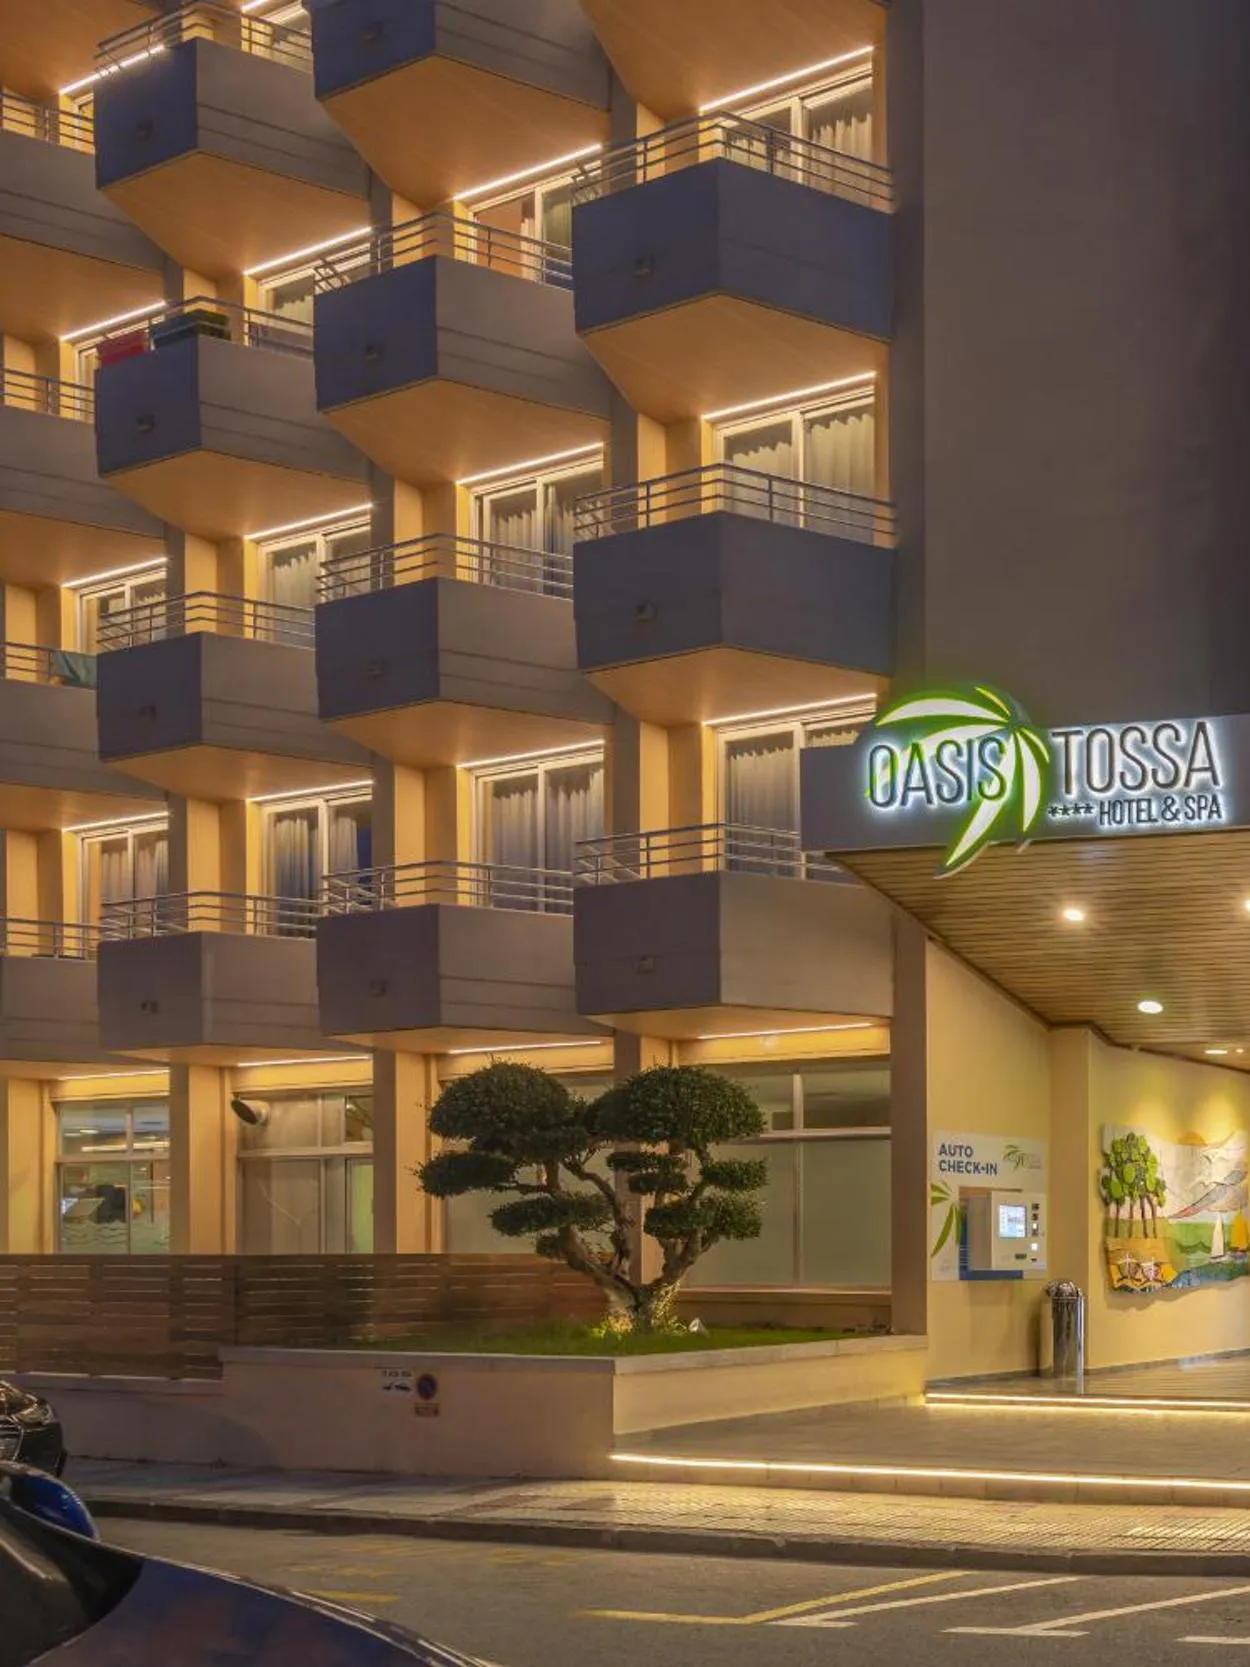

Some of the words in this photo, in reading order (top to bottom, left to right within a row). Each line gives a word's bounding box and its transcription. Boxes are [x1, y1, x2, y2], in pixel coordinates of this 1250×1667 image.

[869, 736, 1008, 808] OASIS
[1052, 720, 1220, 795] TOSSA
[1100, 798, 1158, 826] HOTEL
[1161, 796, 1180, 822] &
[1184, 794, 1222, 821] SPA
[938, 1143, 974, 1159] AUTO
